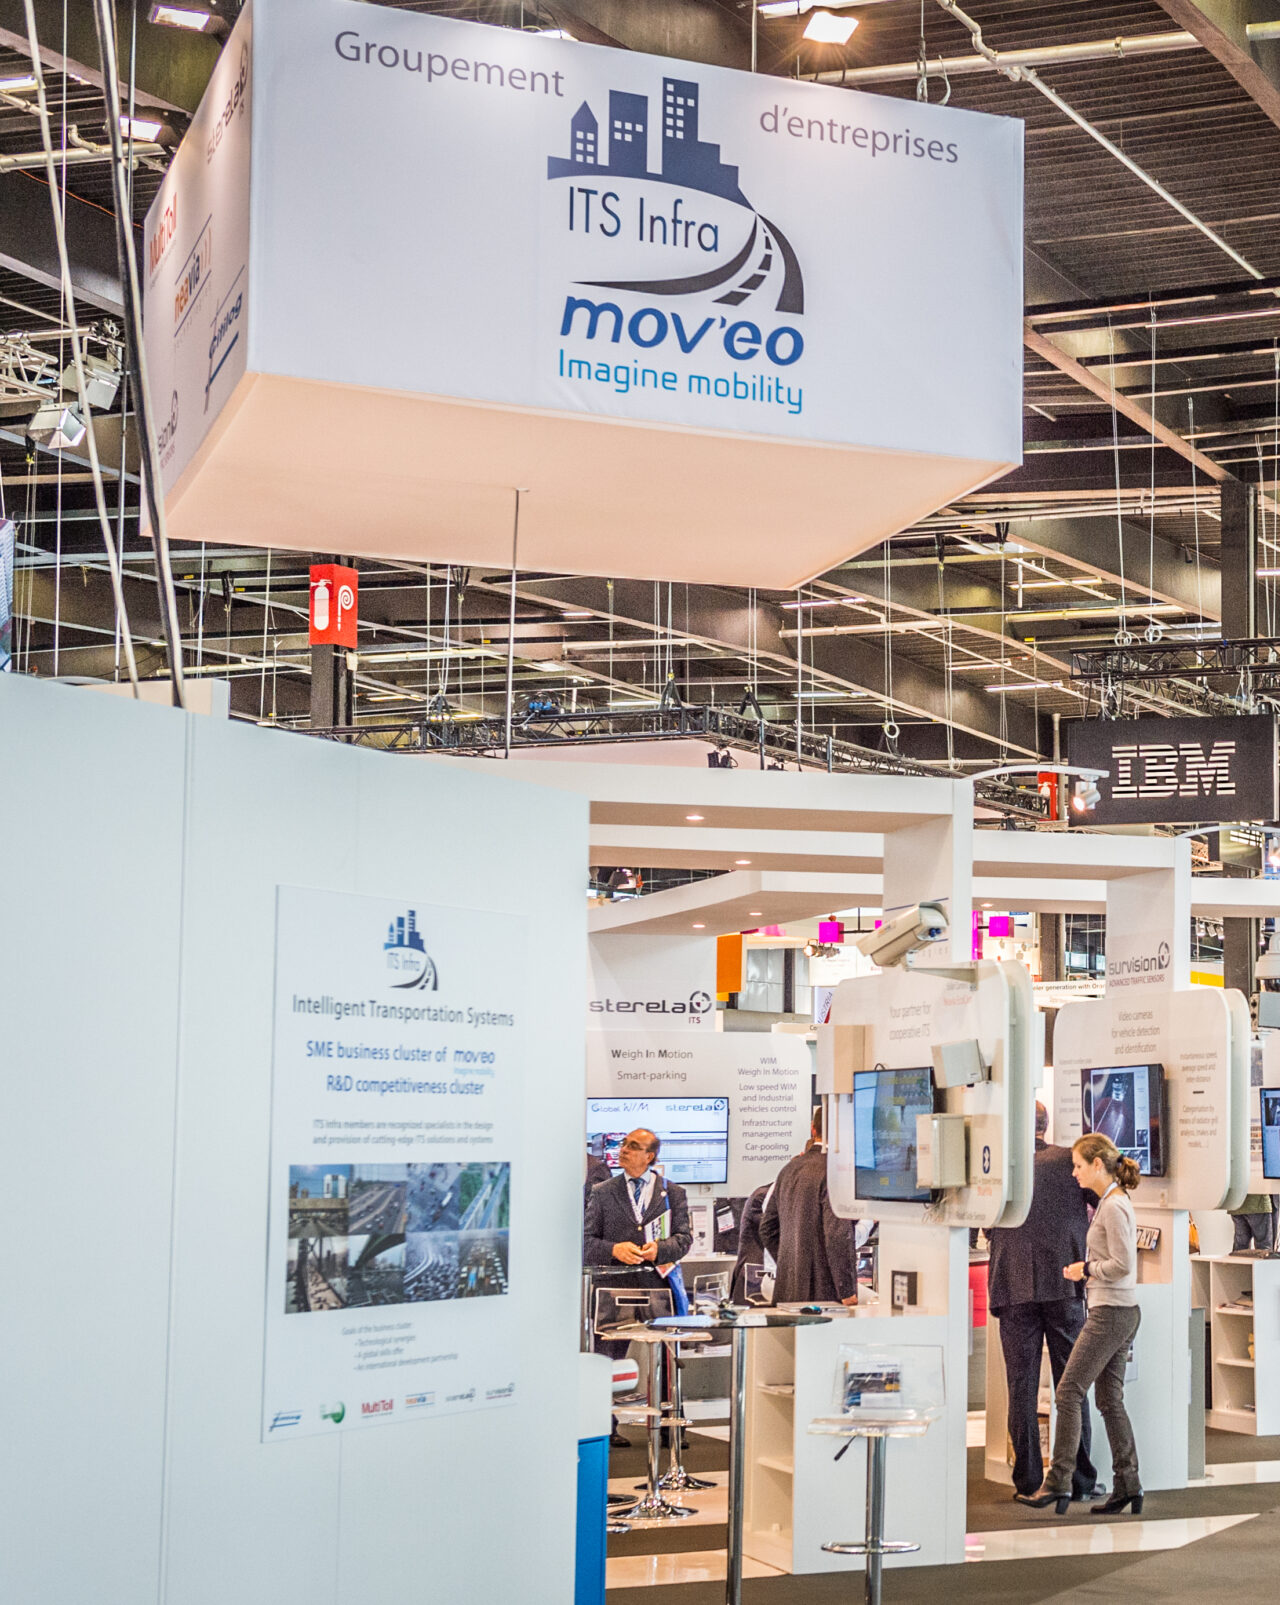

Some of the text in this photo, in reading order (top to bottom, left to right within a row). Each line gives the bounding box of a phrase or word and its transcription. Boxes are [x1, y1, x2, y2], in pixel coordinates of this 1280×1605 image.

[334, 29, 565, 99] Groupement
[758, 102, 960, 165] d'entreprises
[567, 186, 720, 254] ITS Infra
[558, 348, 804, 416] Imagine mobility
[1111, 741, 1236, 799] IBM
[1109, 957, 1158, 976] survision
[1045, 984, 1077, 992] generation
[589, 998, 687, 1014] sterela
[292, 995, 514, 1029] Intelligent Transportation Systems
[688, 1016, 701, 1024] ITS
[306, 1039, 333, 1059] SME
[337, 1042, 389, 1061] business
[393, 1044, 432, 1062] cluster
[435, 1045, 447, 1062] of
[611, 1049, 693, 1060] Weigh In Motion
[617, 1071, 687, 1082] Smart-parking
[738, 1068, 762, 1077] Weigh
[772, 1068, 799, 1076] Motion
[326, 1074, 484, 1096] R&D competitiveness cluster
[739, 1083, 754, 1091] Low
[756, 1083, 778, 1092] speed
[742, 1094, 794, 1102] and Industrial
[739, 1105, 797, 1113] vehicles control
[742, 1119, 793, 1127] Infrastructure
[742, 1131, 792, 1139] management
[745, 1143, 789, 1151] Car-pooling
[742, 1154, 792, 1163] management
